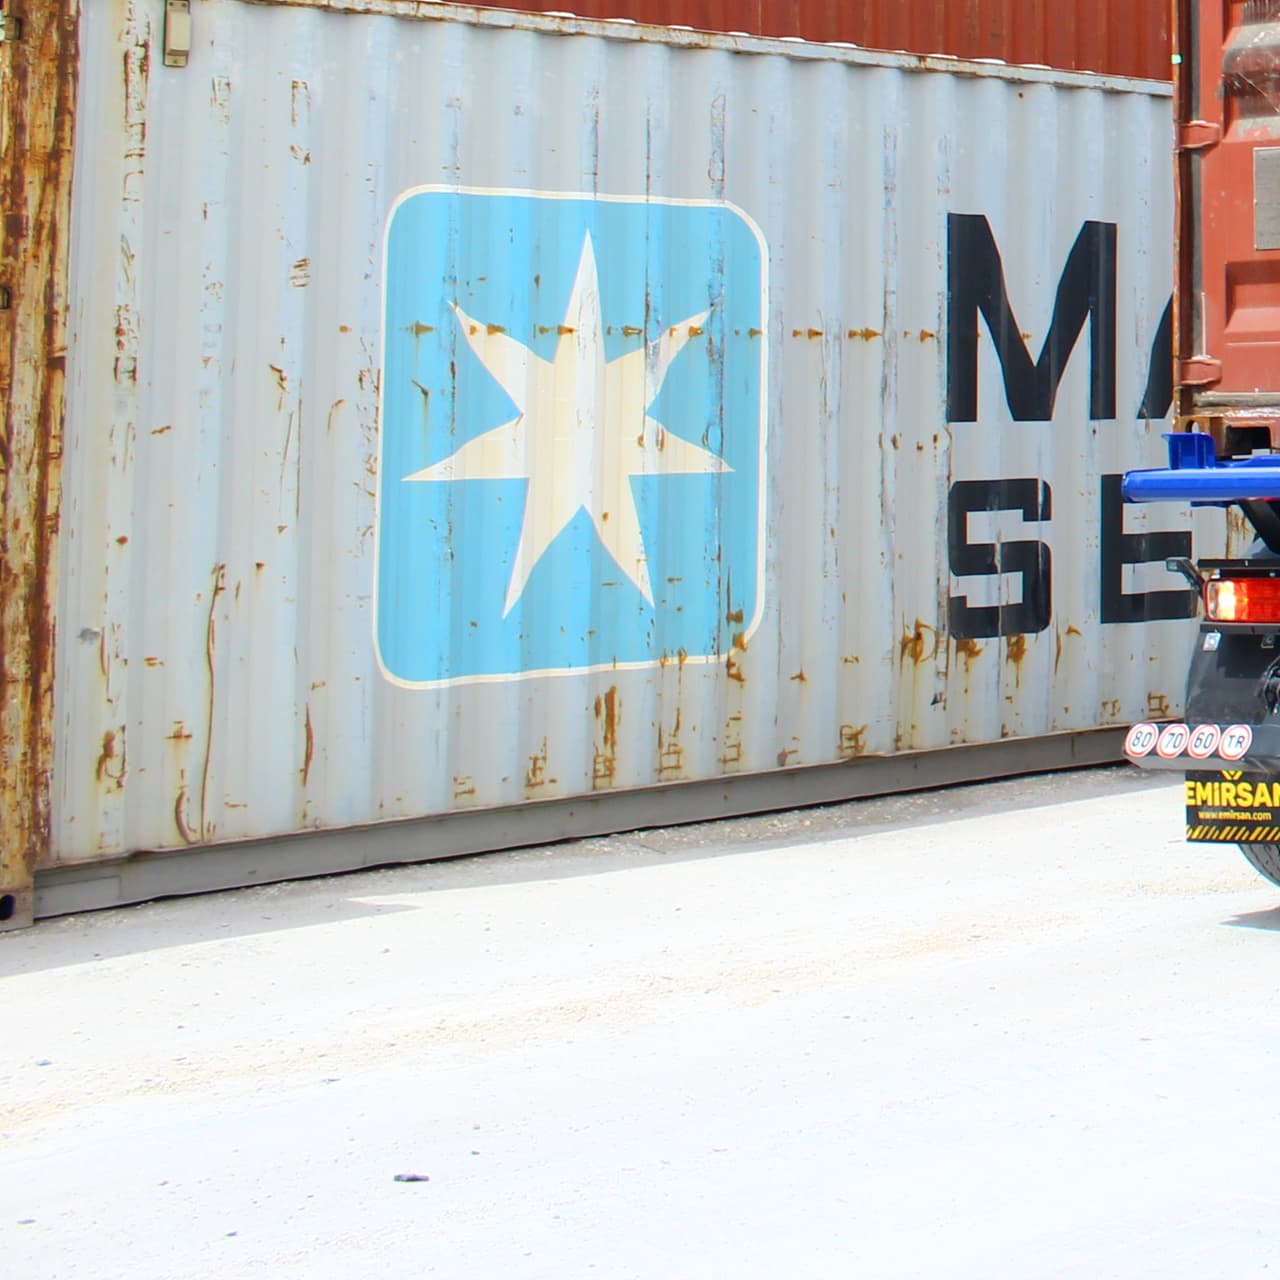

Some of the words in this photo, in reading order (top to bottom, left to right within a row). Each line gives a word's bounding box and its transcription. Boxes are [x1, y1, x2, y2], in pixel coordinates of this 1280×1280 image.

[1132, 731, 1152, 748] 80
[1164, 732, 1184, 749] 70
[1194, 732, 1215, 749] 60
[1228, 734, 1245, 750] TR
[1198, 810, 1272, 821] www.emirsan.com
